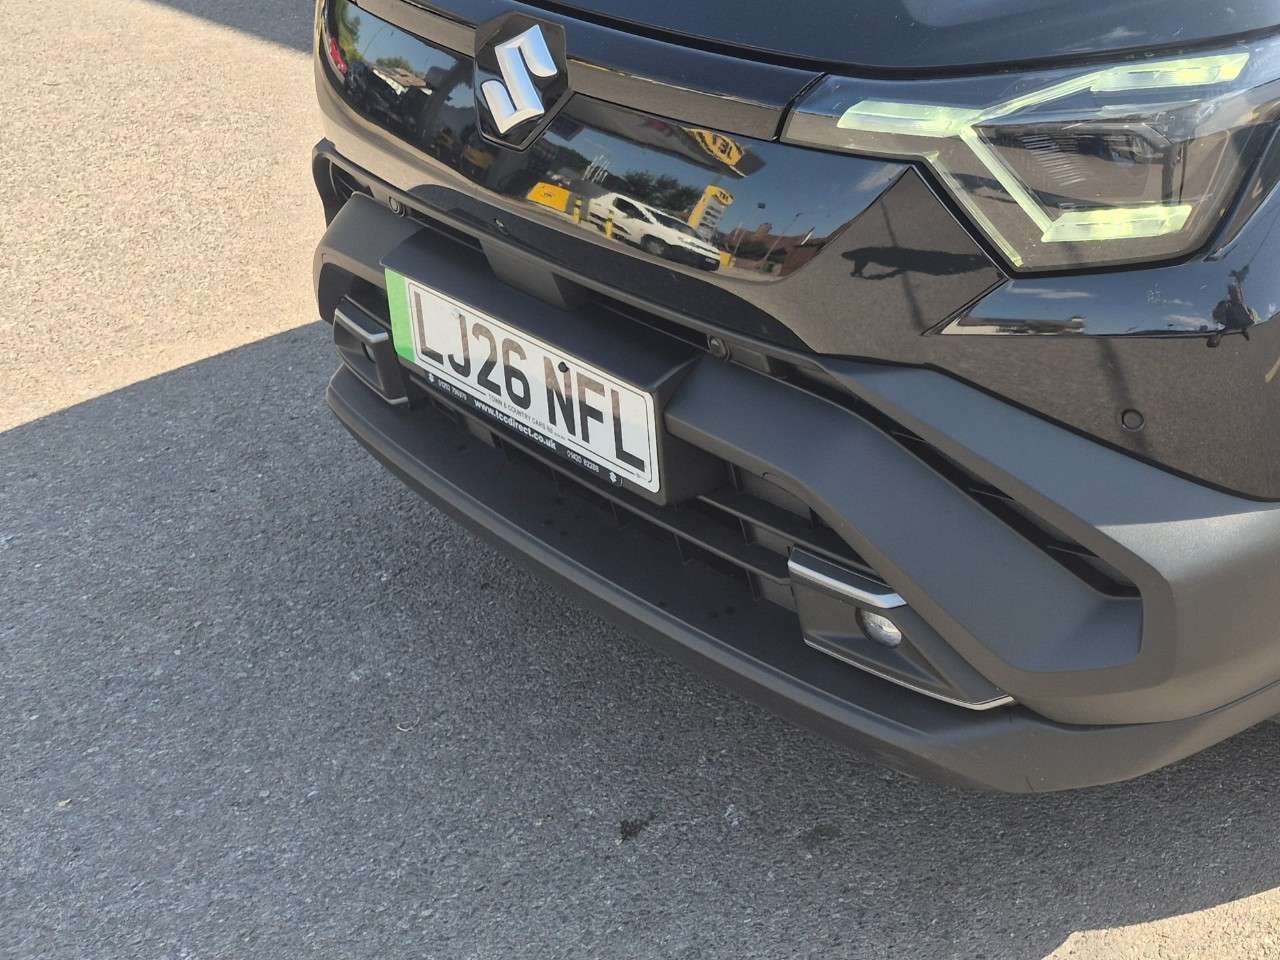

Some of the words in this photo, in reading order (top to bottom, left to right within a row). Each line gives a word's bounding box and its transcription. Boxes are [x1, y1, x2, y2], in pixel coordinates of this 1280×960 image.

[413, 290, 532, 410] LJ26
[543, 355, 646, 473] NFL
[474, 399, 557, 450] www.tccdirect.co.uk
